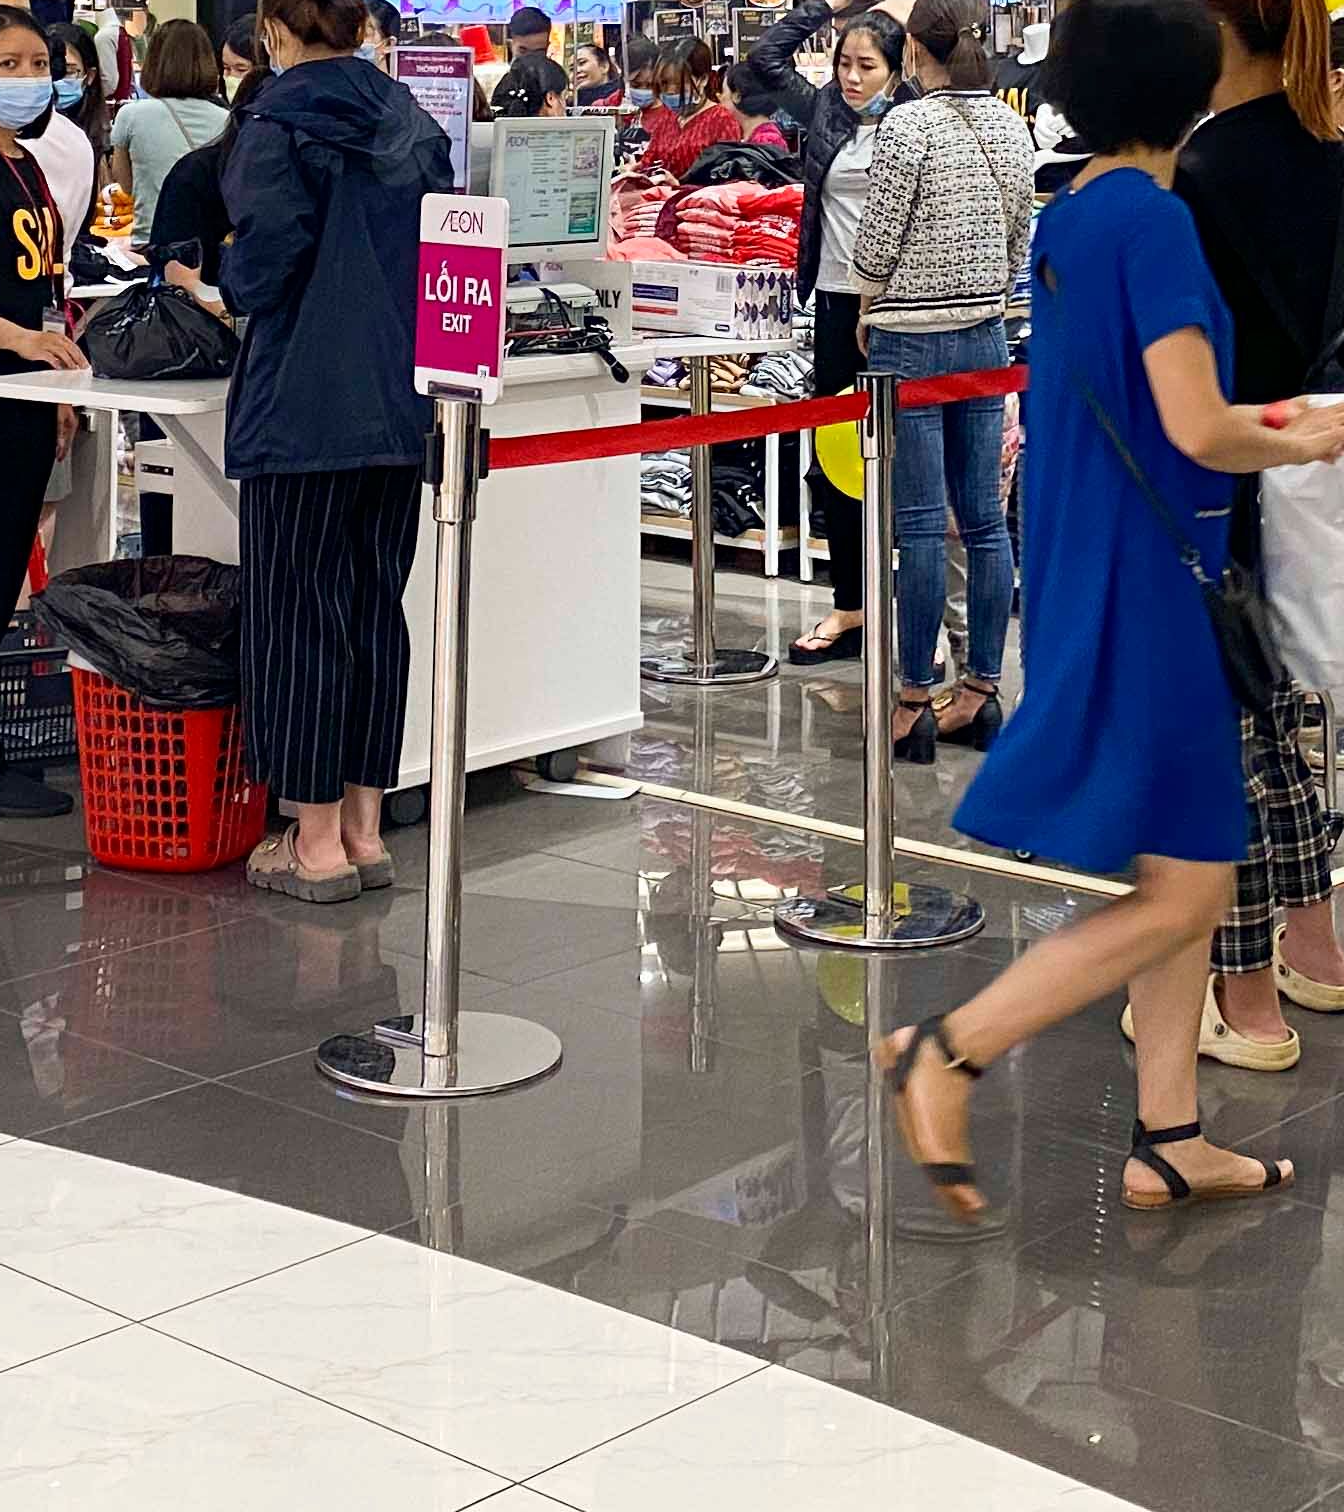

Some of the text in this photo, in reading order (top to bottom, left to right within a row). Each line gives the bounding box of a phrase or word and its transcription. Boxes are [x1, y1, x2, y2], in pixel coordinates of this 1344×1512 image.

[425, 260, 493, 307] LỐI RA
[596, 288, 621, 309] NLY
[442, 312, 473, 334] EXIT
